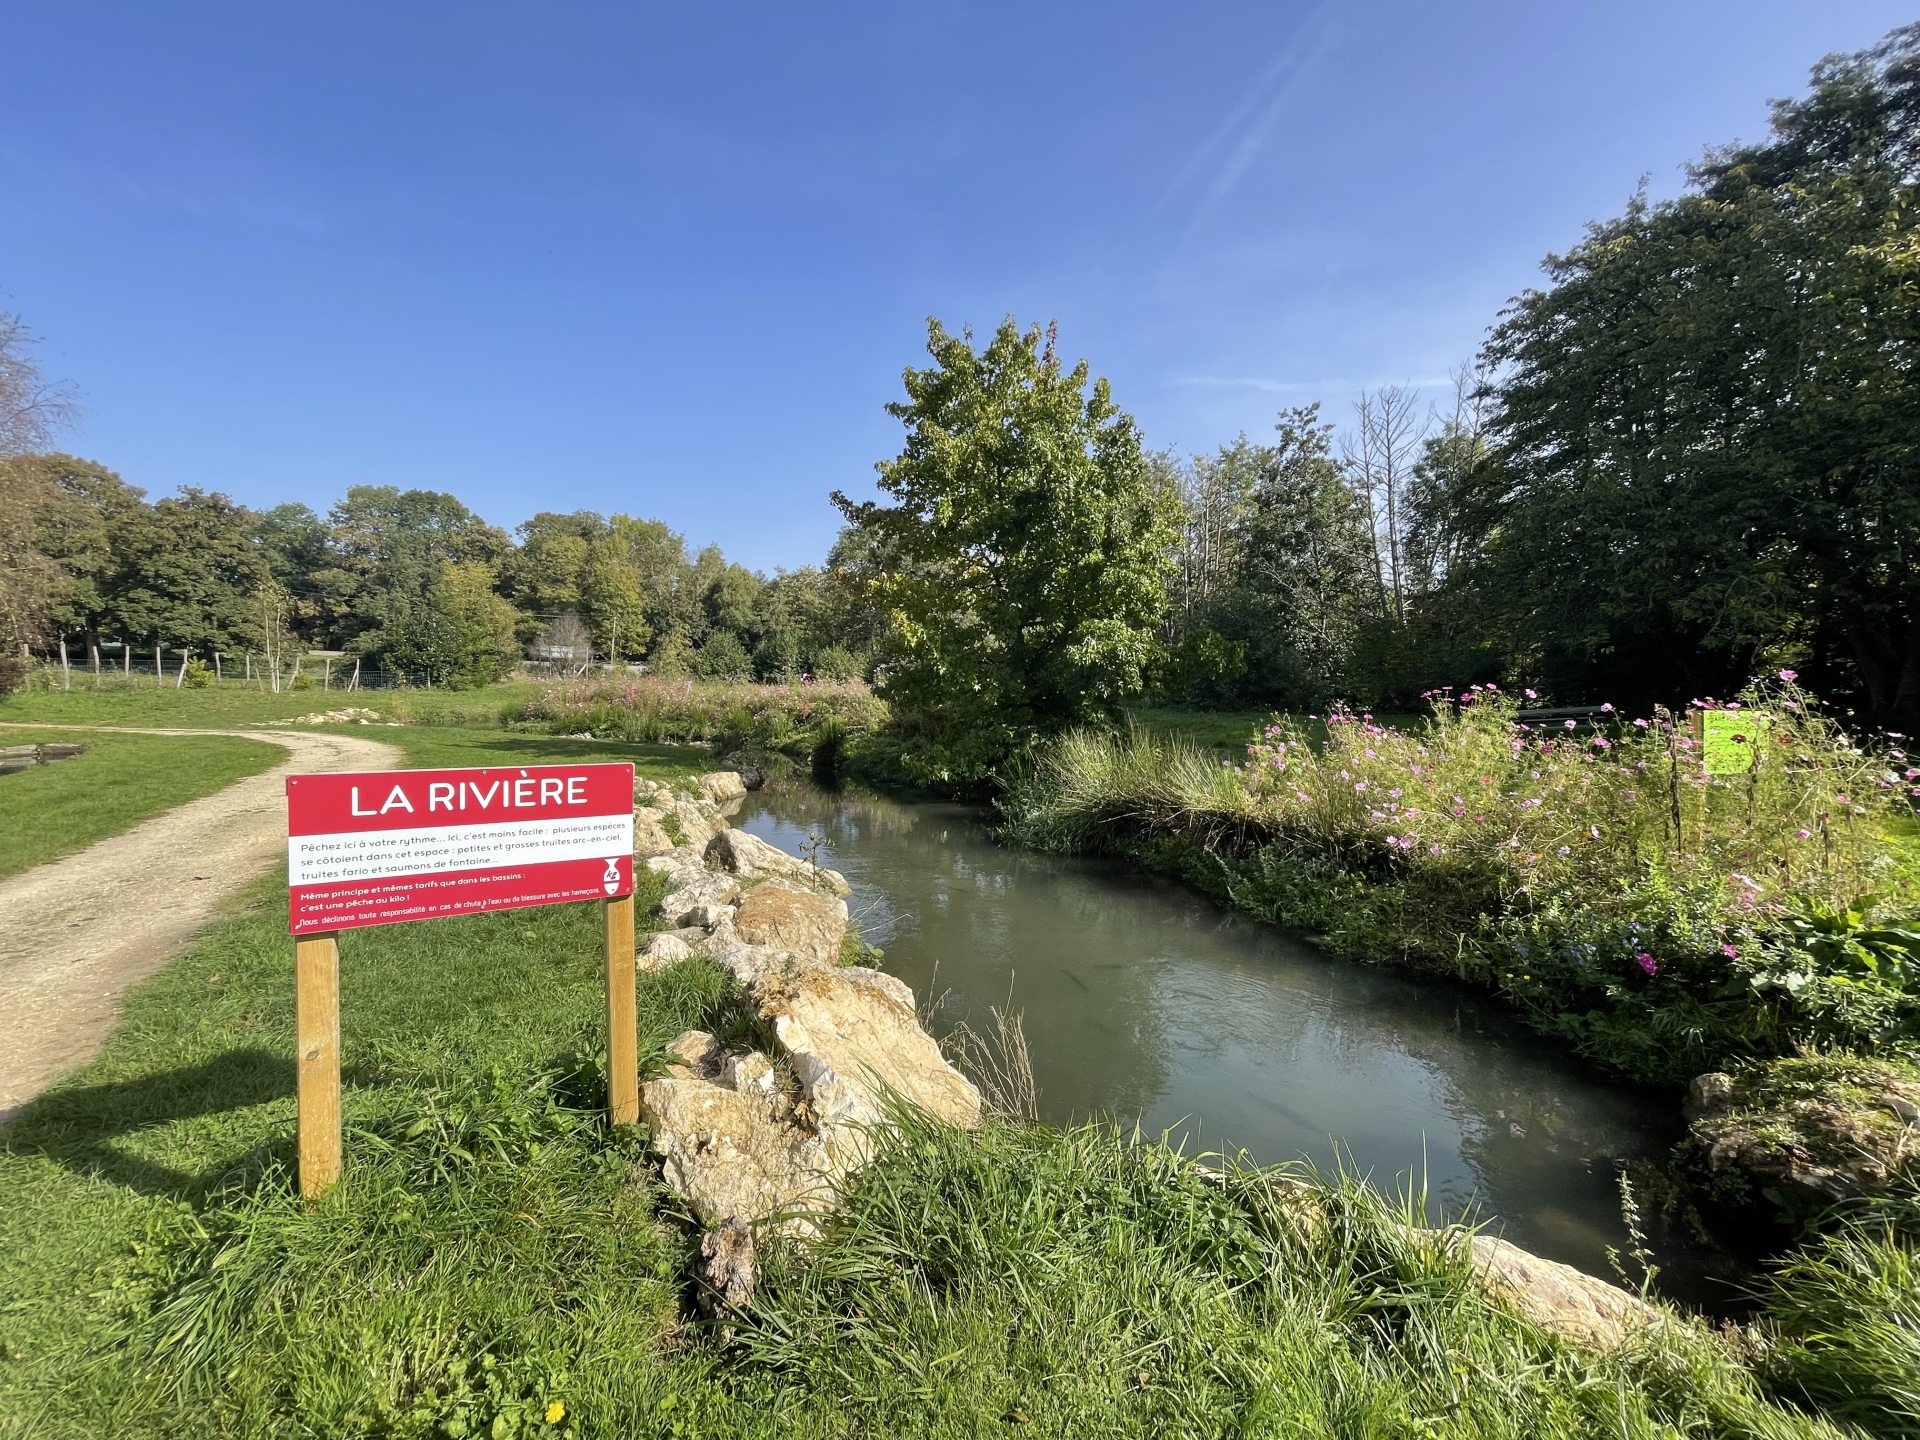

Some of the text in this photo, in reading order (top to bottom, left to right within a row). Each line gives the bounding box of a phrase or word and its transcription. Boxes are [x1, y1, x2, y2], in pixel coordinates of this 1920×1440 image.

[351, 769, 588, 816] LA RIVIÈRE
[301, 843, 340, 852] Pêchez
[359, 839, 366, 848] à
[399, 837, 446, 846] rythme...
[464, 833, 486, 841] c'est
[489, 830, 516, 838] moins
[519, 828, 543, 836] facile
[553, 826, 591, 835] plusieurs
[593, 823, 625, 831] espèces
[317, 855, 363, 864] côtoient
[414, 849, 449, 859] espace
[458, 845, 490, 854] petites
[505, 842, 539, 851] grosses
[542, 838, 570, 846] truites
[301, 871, 339, 880] truites
[342, 868, 368, 876] fario
[385, 863, 431, 872] saumons
[434, 859, 446, 867] de
[449, 858, 499, 867] fontaine...
[607, 871, 617, 879] kg
[301, 892, 329, 900] Même
[331, 888, 369, 899] principe
[383, 884, 413, 892] mêmes
[415, 881, 438, 889] tarifs
[493, 873, 521, 881] bassins
[295, 919, 318, 929] Nous
[322, 915, 355, 924] déclinons
[380, 906, 425, 918] responsabilité
[522, 893, 546, 901] blessure
[301, 904, 323, 912] c'est
[346, 898, 373, 908] pêche
